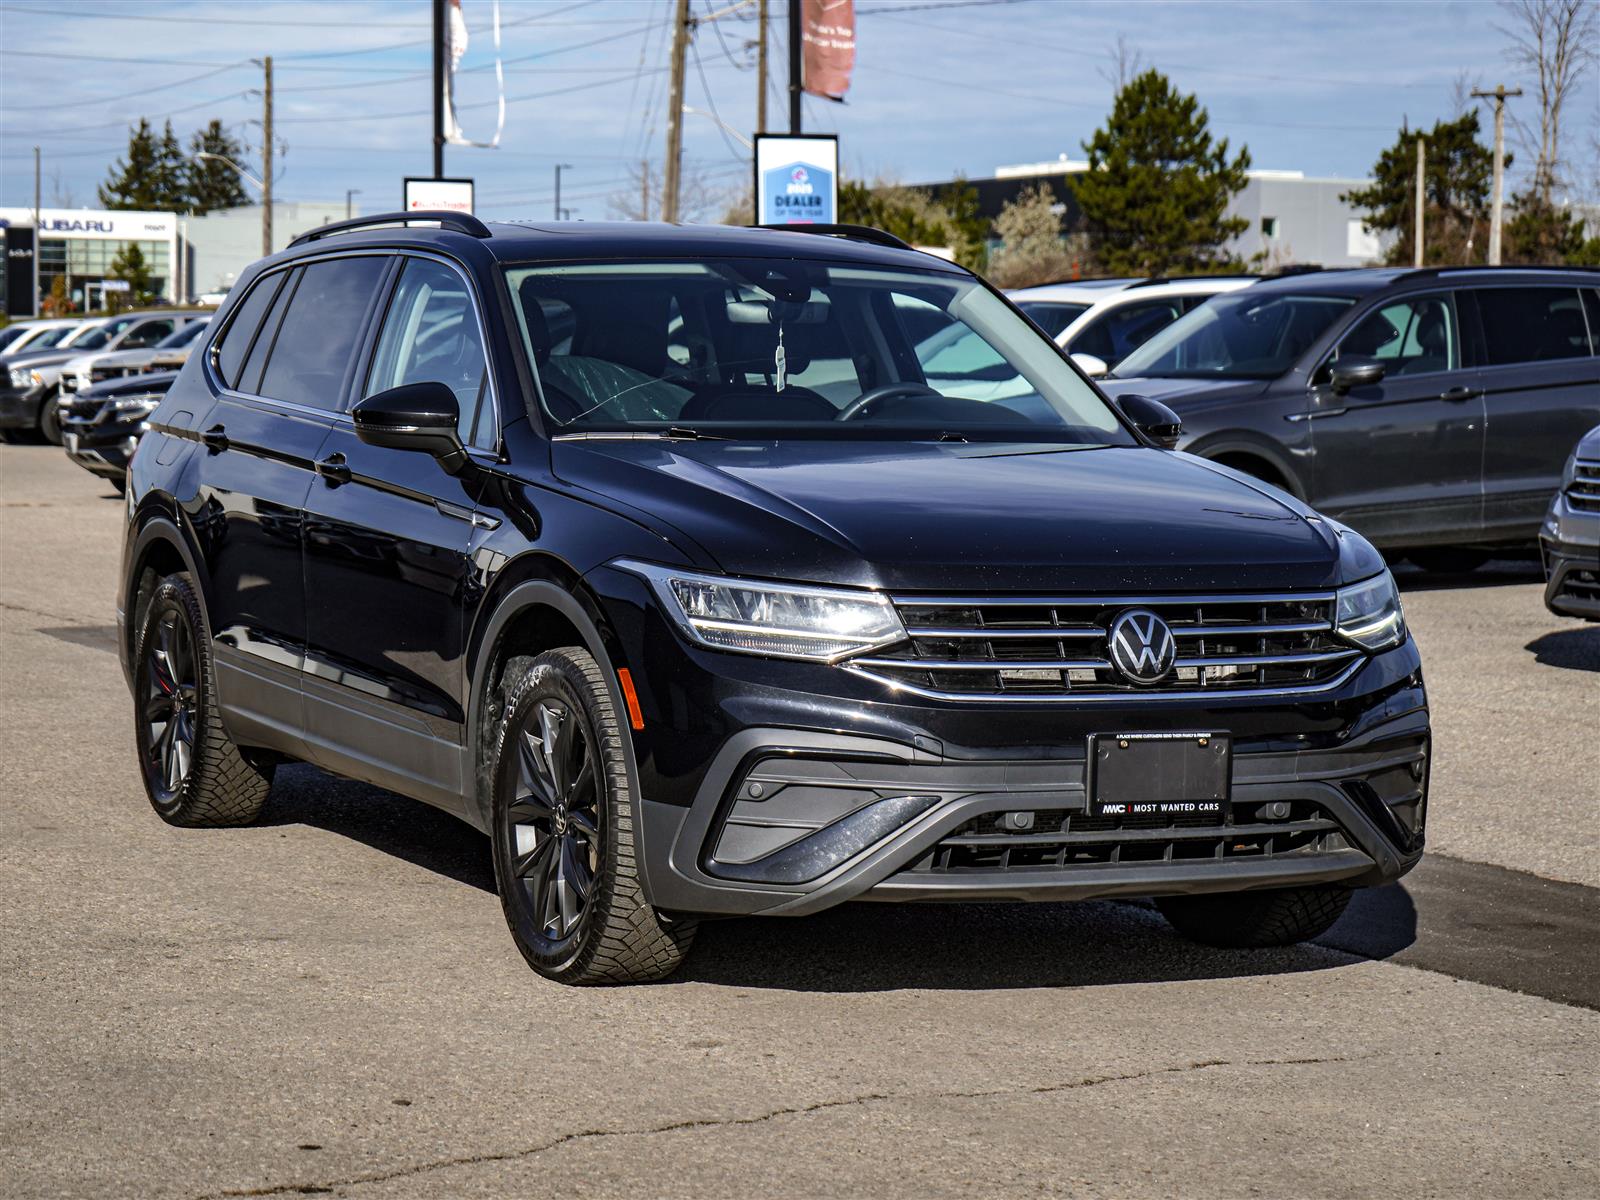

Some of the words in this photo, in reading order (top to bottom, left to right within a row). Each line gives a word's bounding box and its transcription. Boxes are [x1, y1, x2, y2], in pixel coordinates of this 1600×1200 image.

[775, 195, 822, 207] DEALER
[1134, 804, 1157, 813] MOST
[1161, 803, 1195, 812] WANTED
[1199, 803, 1220, 811] CARS
